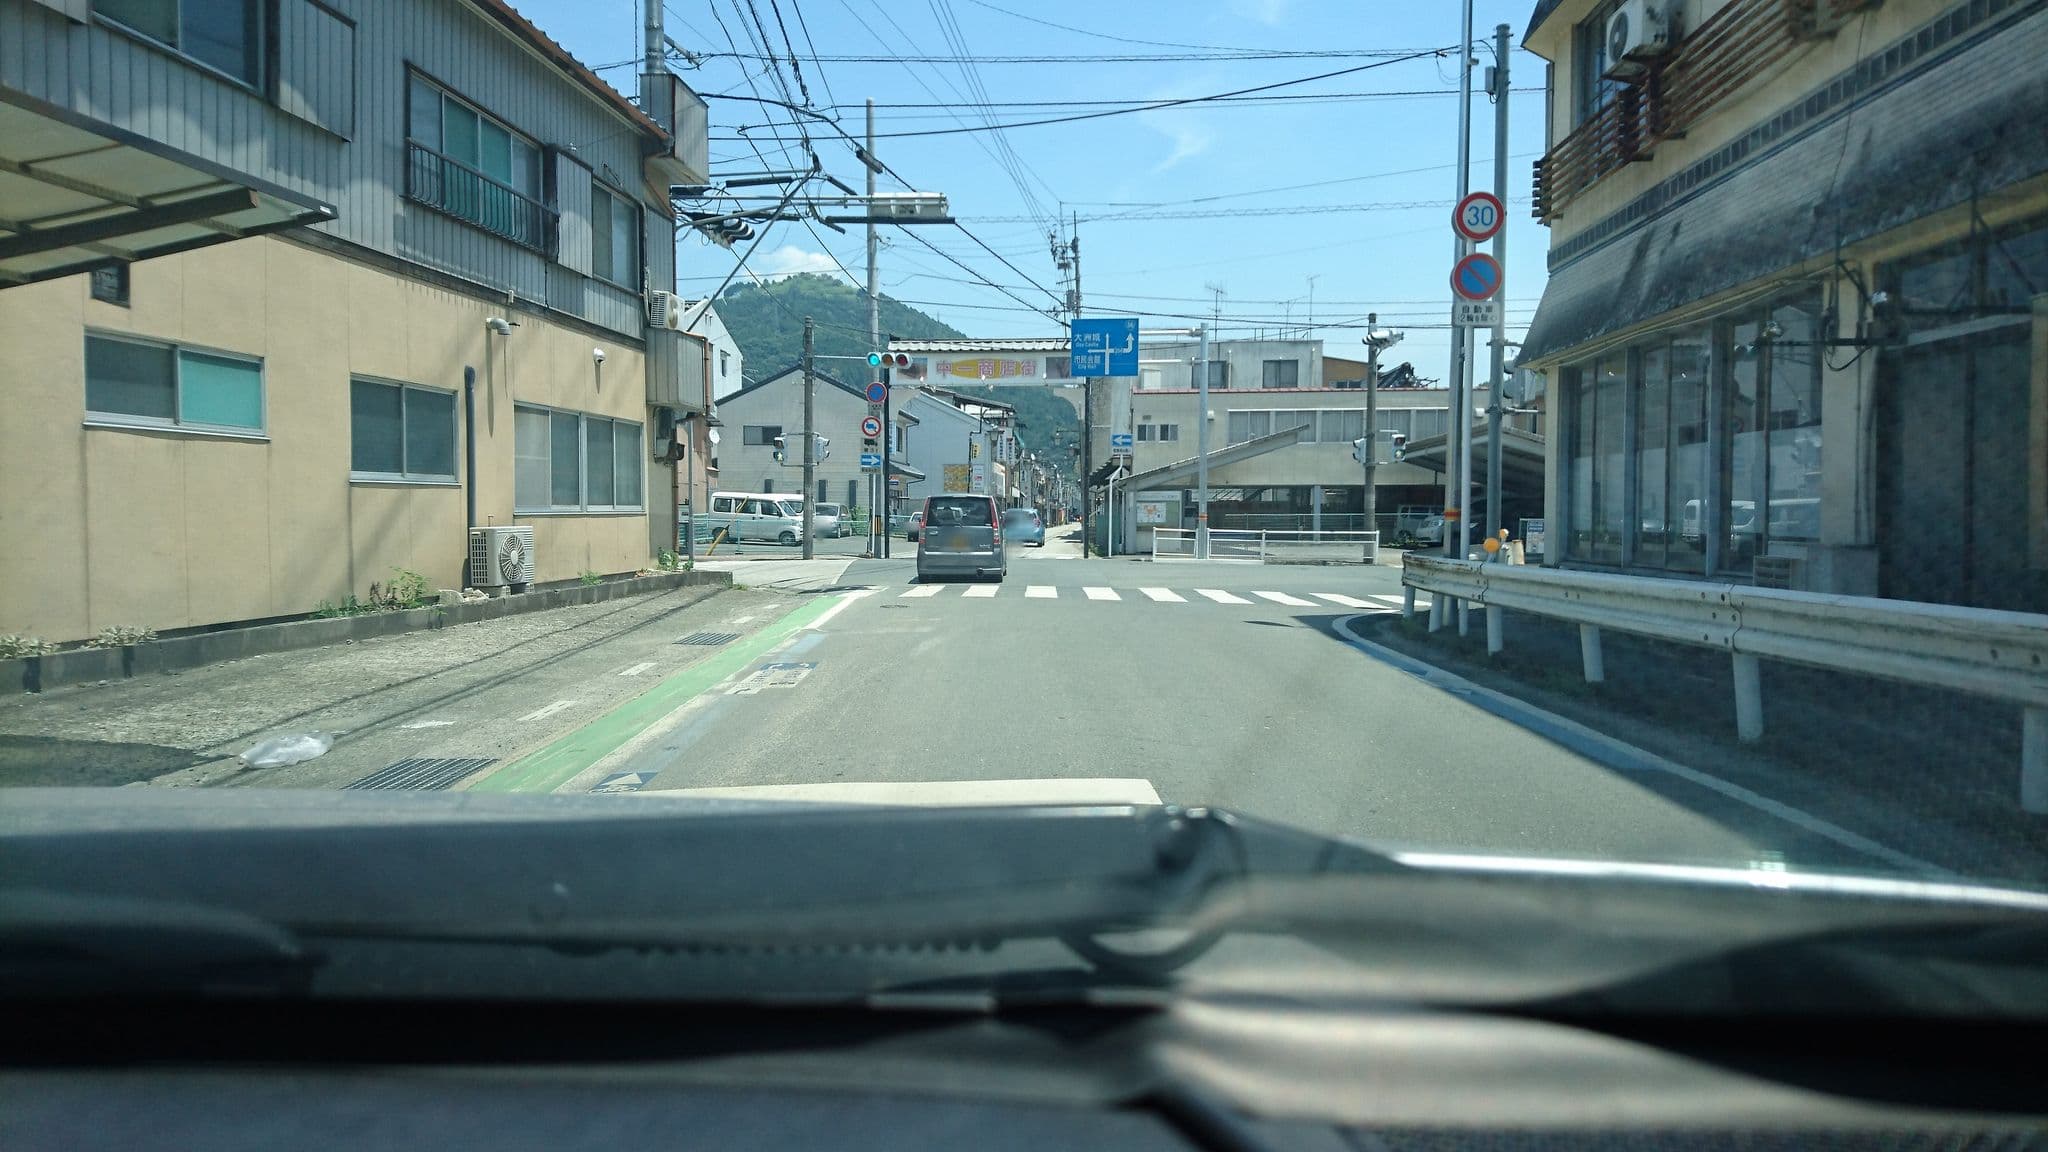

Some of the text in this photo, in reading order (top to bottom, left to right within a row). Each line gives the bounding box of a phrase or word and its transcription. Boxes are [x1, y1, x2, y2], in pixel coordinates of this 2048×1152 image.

[1467, 206, 1494, 226] 30
[1462, 305, 1494, 314] 自動車
[936, 359, 1037, 378] 中一商店街
